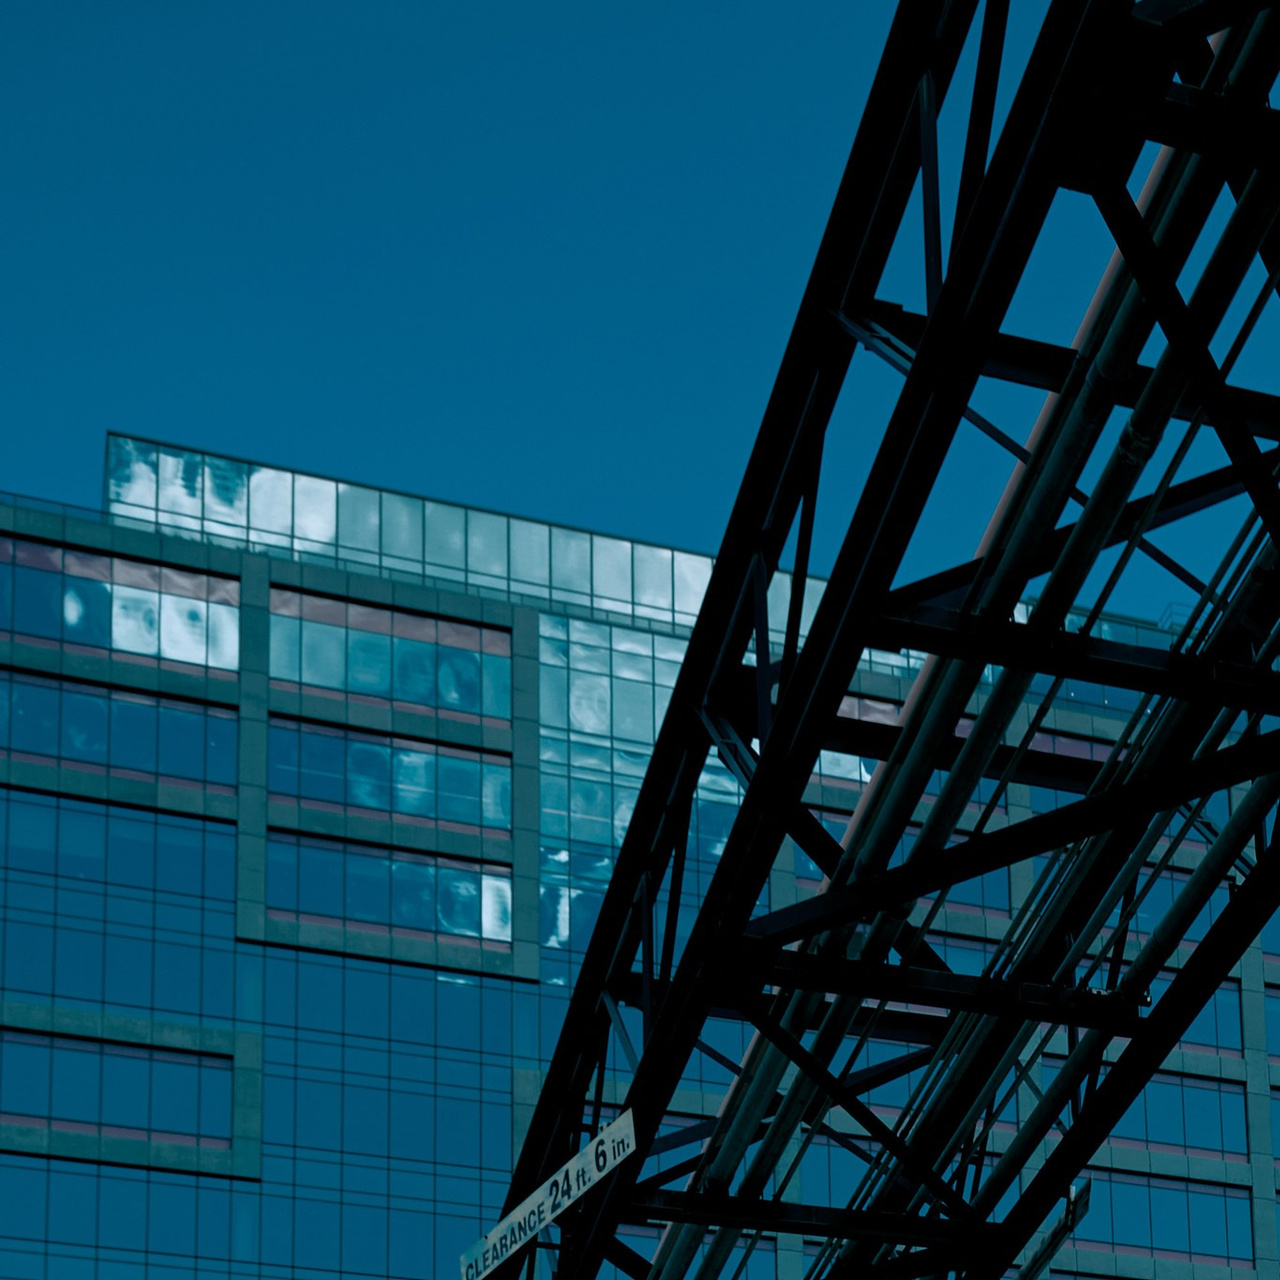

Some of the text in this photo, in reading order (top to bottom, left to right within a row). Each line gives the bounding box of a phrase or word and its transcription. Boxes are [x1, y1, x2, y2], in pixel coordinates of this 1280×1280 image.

[549, 1168, 572, 1214] 24
[576, 1170, 591, 1191] ft.
[595, 1139, 607, 1173] 6
[612, 1137, 630, 1160] in.
